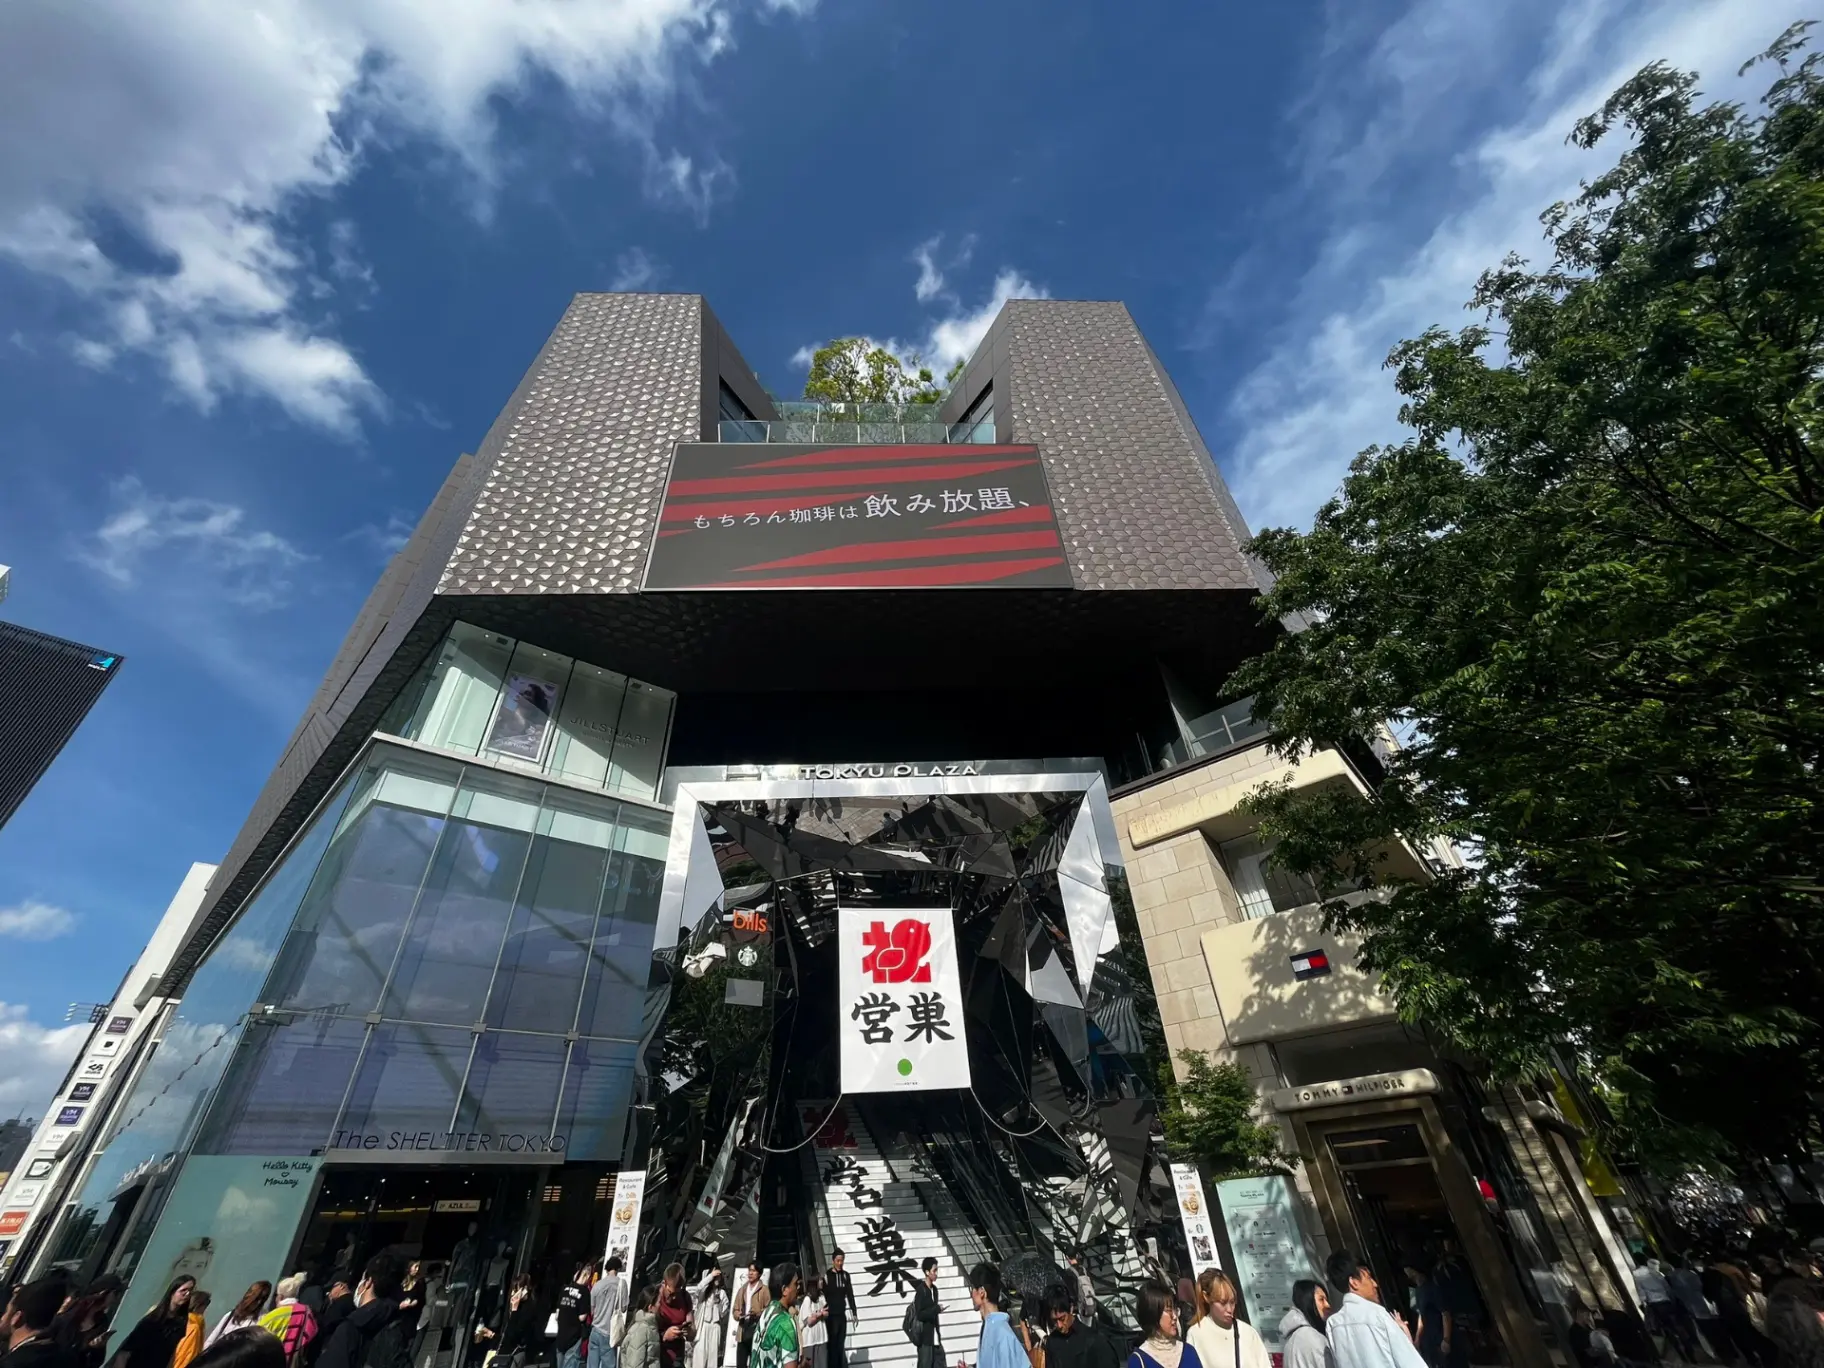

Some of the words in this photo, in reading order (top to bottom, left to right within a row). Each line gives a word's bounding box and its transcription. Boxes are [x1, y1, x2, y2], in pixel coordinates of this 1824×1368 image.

[693, 486, 1032, 530] もちろん珈琲は飲み放題、
[801, 767, 884, 780] TOKYU
[893, 764, 978, 778] PLAZA
[733, 909, 769, 933] bills
[851, 992, 955, 1045] 営巣
[1294, 1087, 1338, 1102] TOMMY
[1355, 1078, 1405, 1093] HILFIGER
[336, 1130, 380, 1149] The
[500, 1134, 566, 1152] TOKYO
[262, 1161, 289, 1170] Hello
[291, 1162, 313, 1173] Kitty
